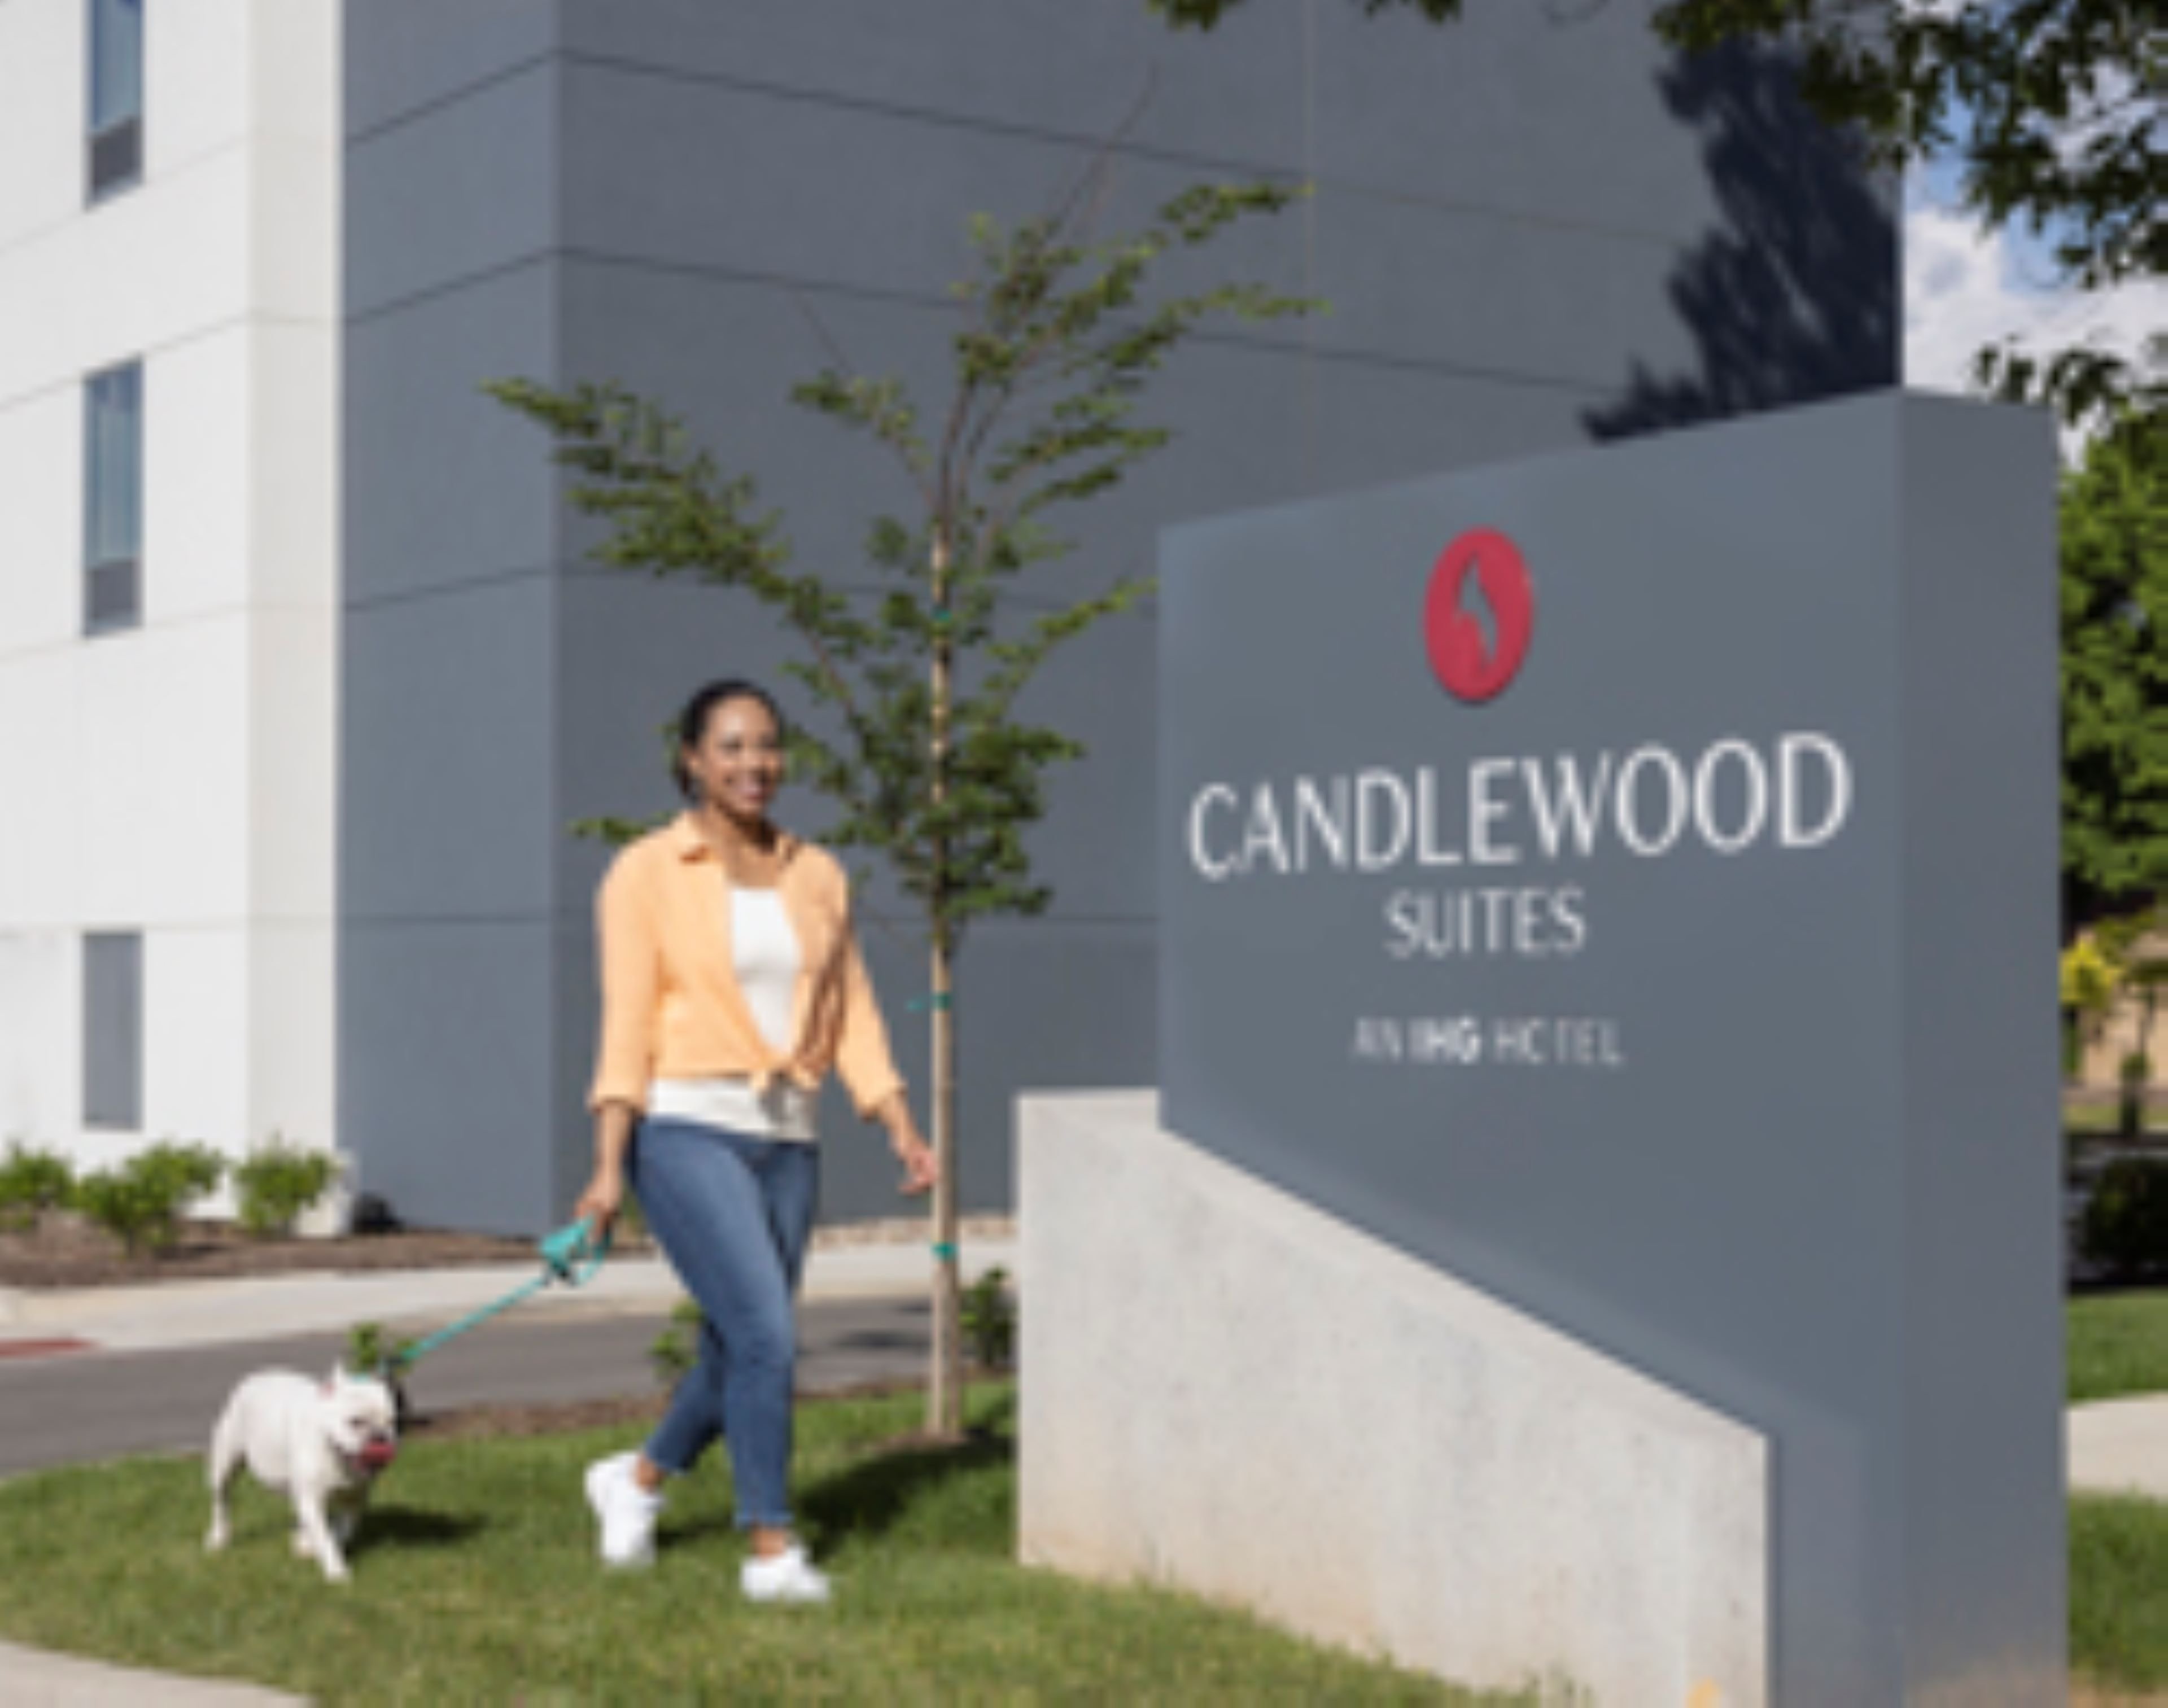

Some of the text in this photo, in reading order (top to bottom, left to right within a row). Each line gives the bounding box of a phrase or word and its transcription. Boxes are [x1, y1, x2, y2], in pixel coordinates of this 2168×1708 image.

[1187, 732, 1852, 879] CANDLEWOOD
[1384, 886, 1588, 958] SUITES
[1409, 1015, 1482, 1064] IHG
